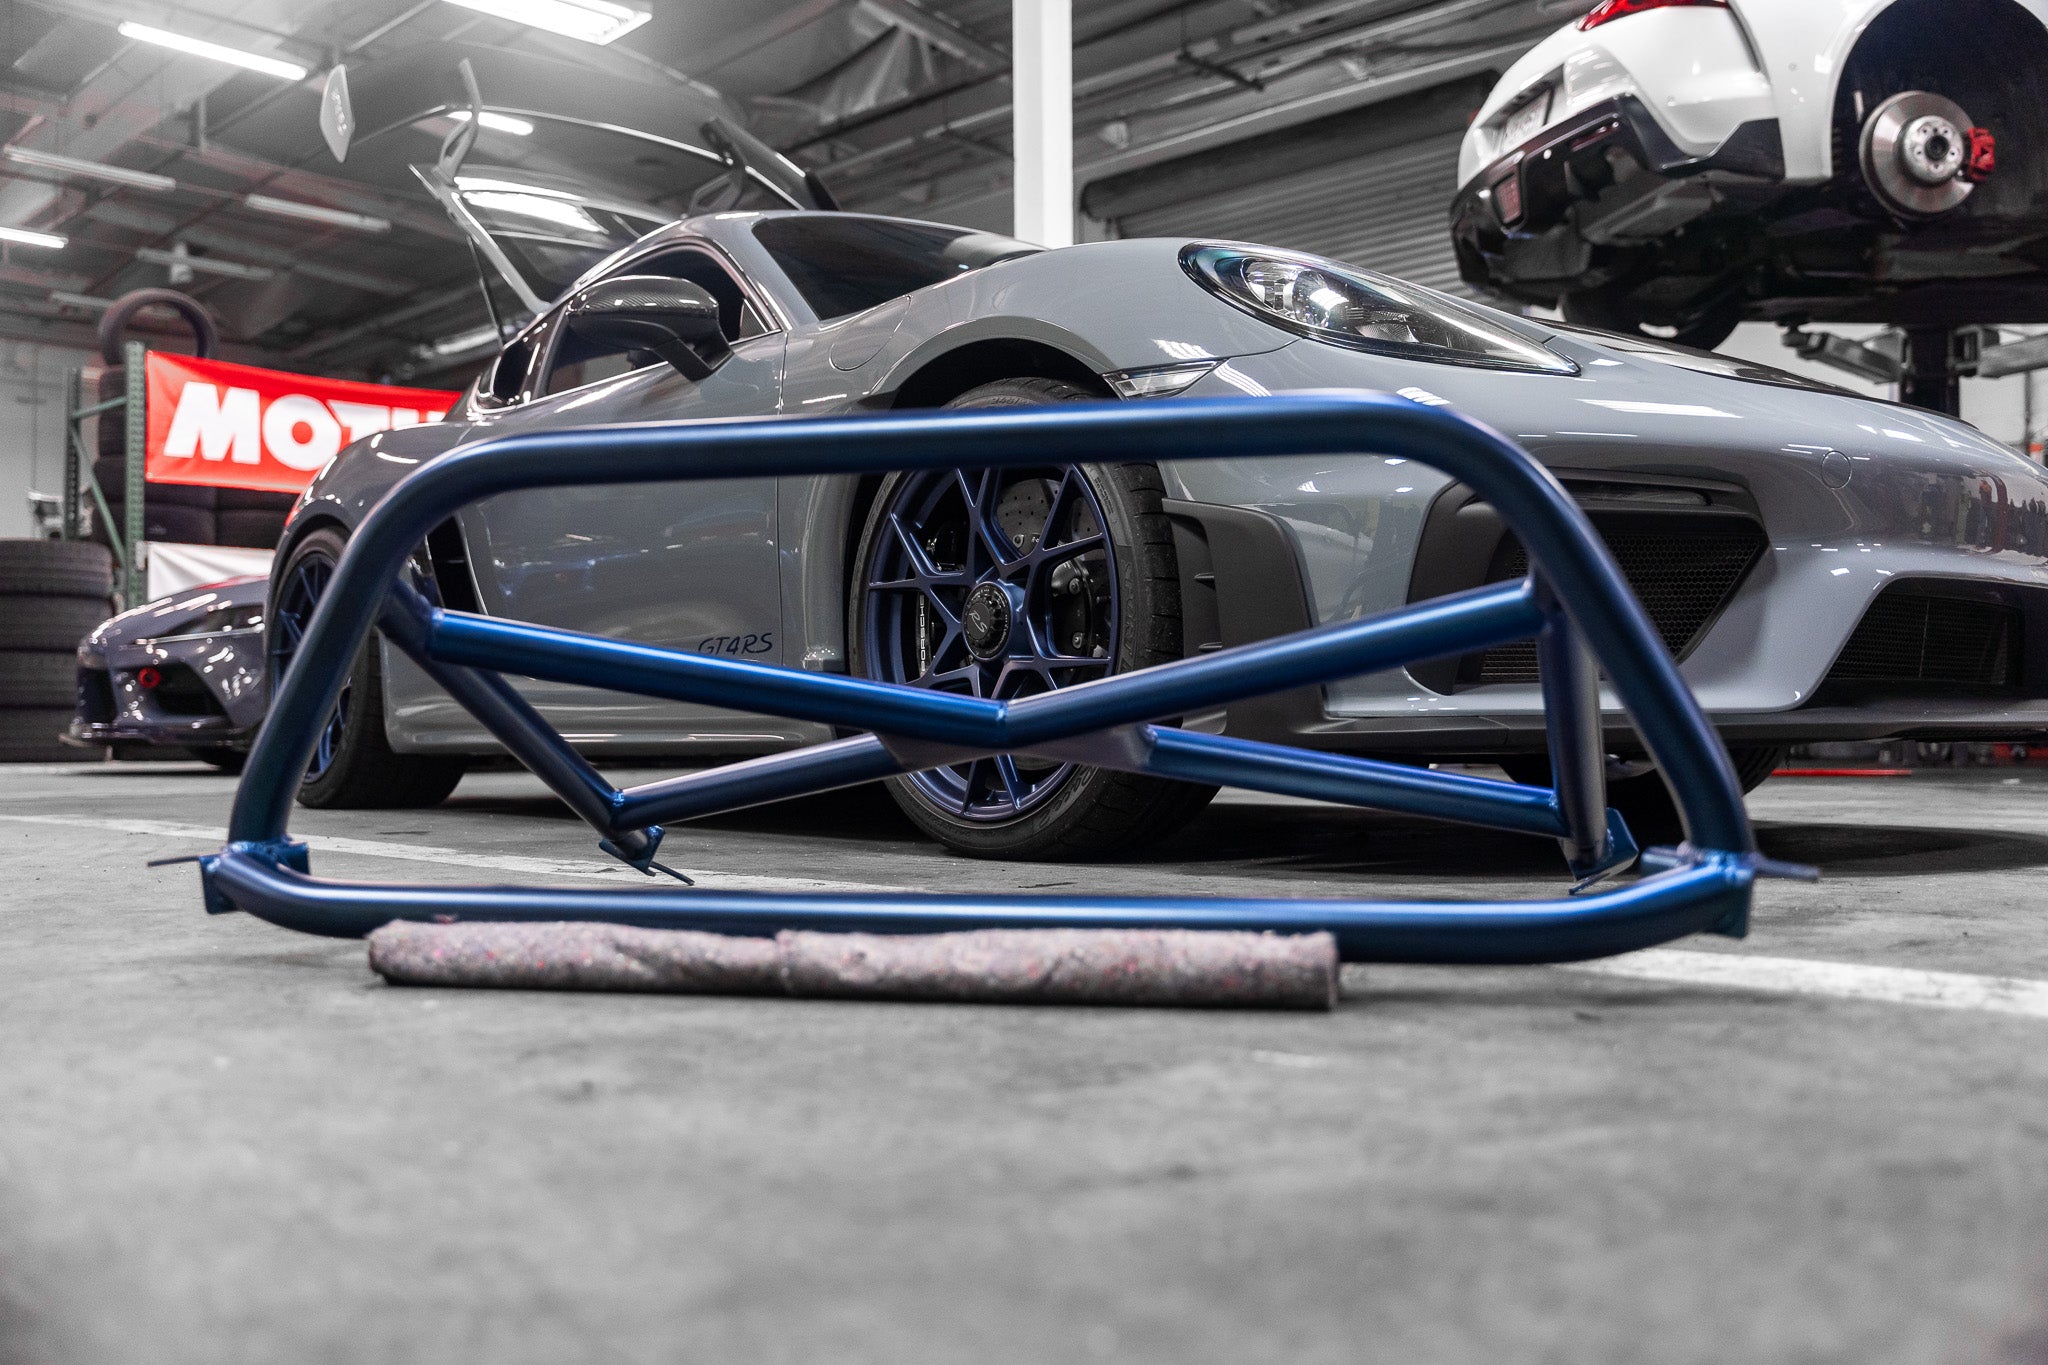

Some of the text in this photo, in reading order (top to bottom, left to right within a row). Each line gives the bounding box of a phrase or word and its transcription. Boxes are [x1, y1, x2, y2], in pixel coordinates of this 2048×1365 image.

[163, 381, 446, 471] MOT
[969, 610, 988, 633] RS
[698, 633, 773, 655] GT4RS
